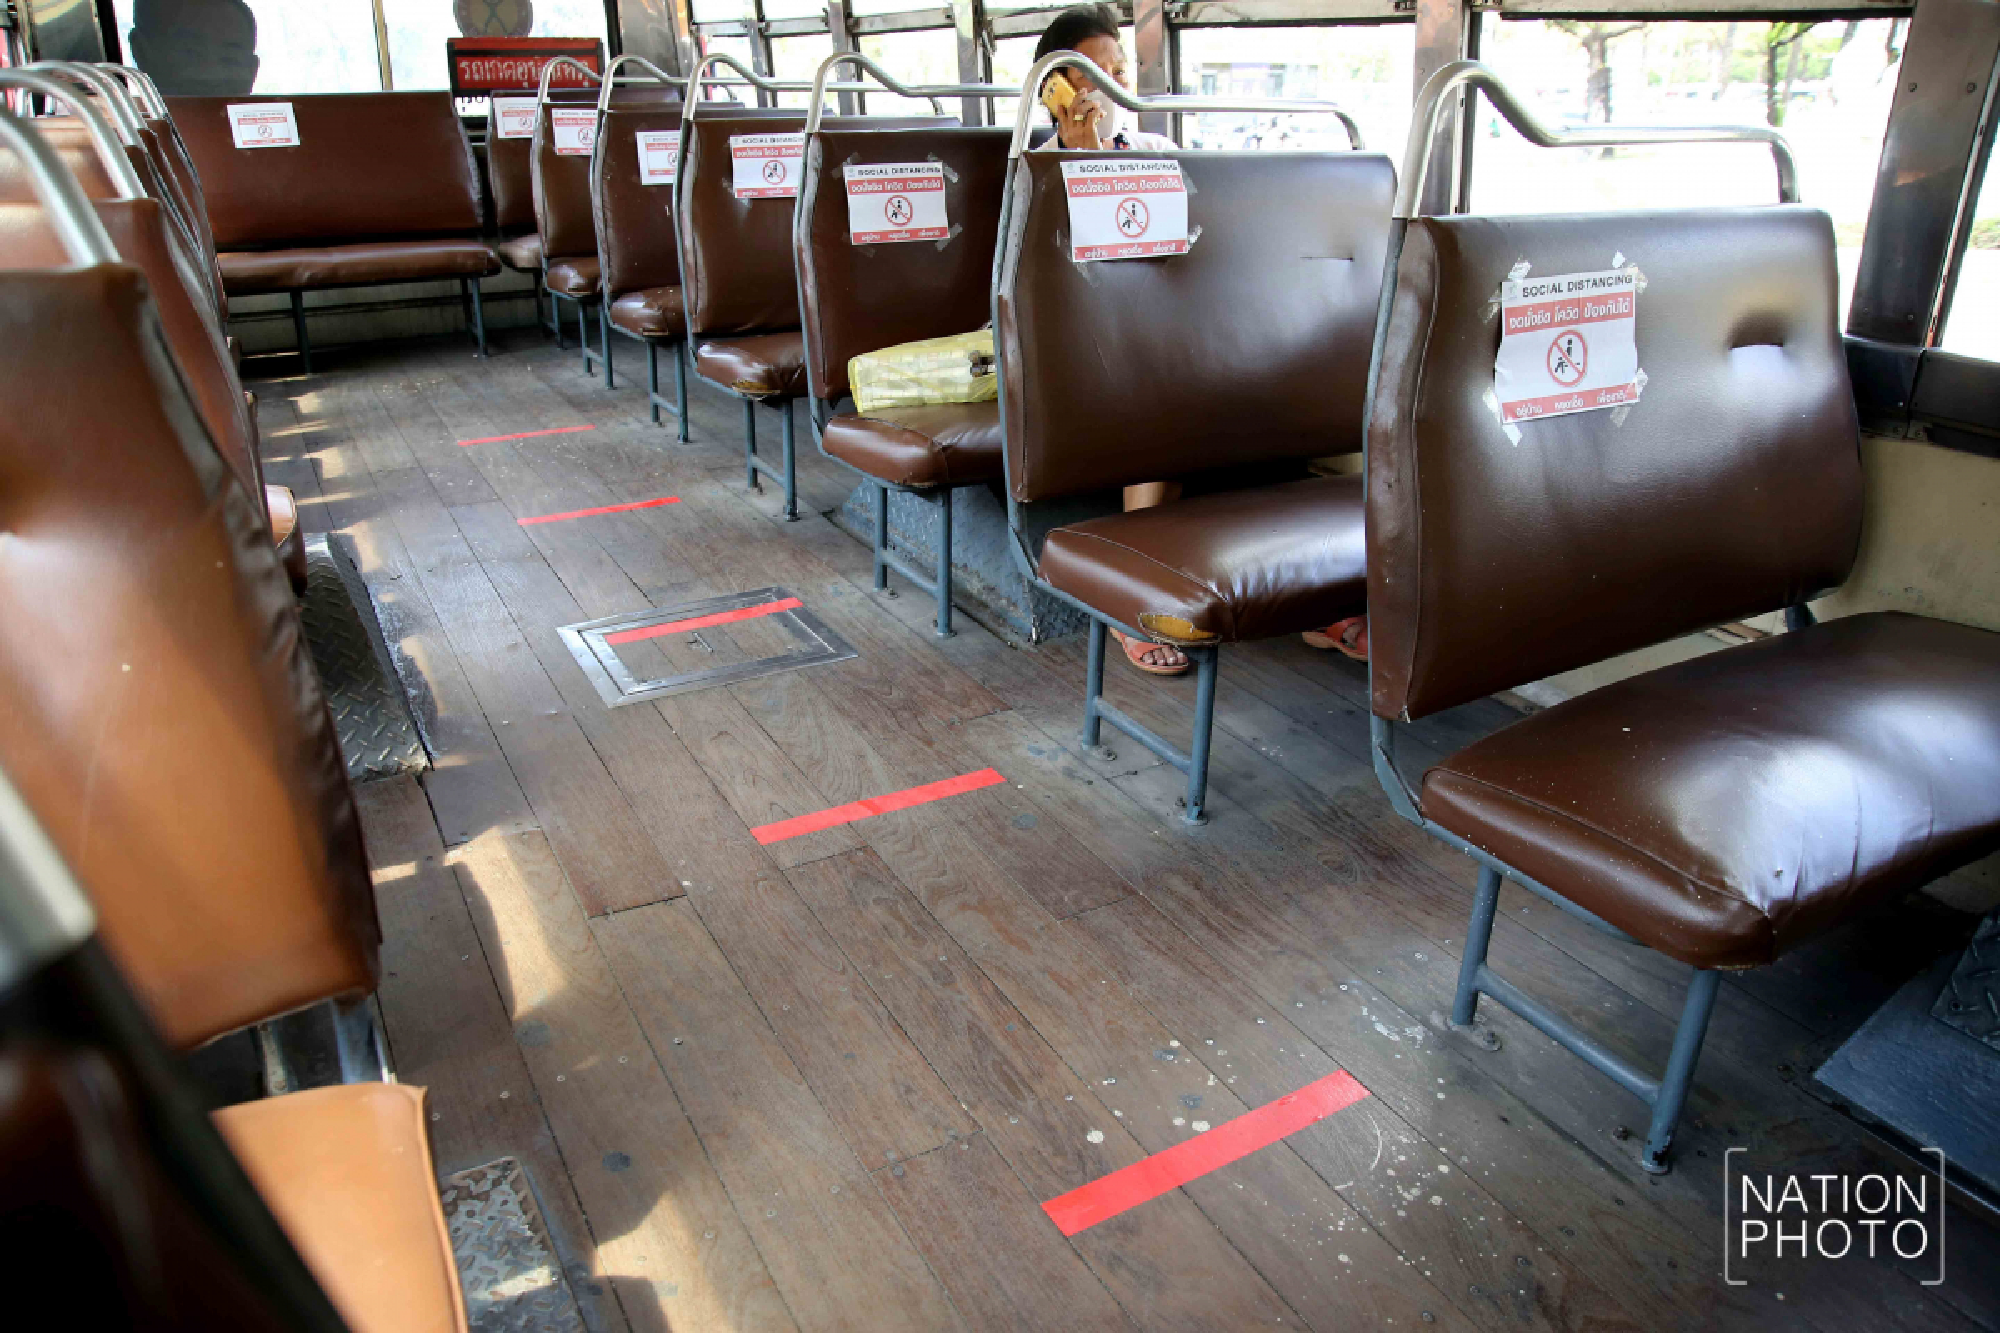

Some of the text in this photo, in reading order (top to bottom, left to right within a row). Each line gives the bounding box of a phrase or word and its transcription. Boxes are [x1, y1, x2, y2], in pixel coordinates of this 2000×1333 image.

[858, 166, 940, 176] SOCIAL DISTANCING
[1079, 163, 1178, 173] SOCIAL DISTANCING
[1522, 274, 1633, 298] SOCIAL DISTANCING
[1554, 305, 1579, 323] โควิด
[1584, 297, 1631, 318] ป้องกันได้
